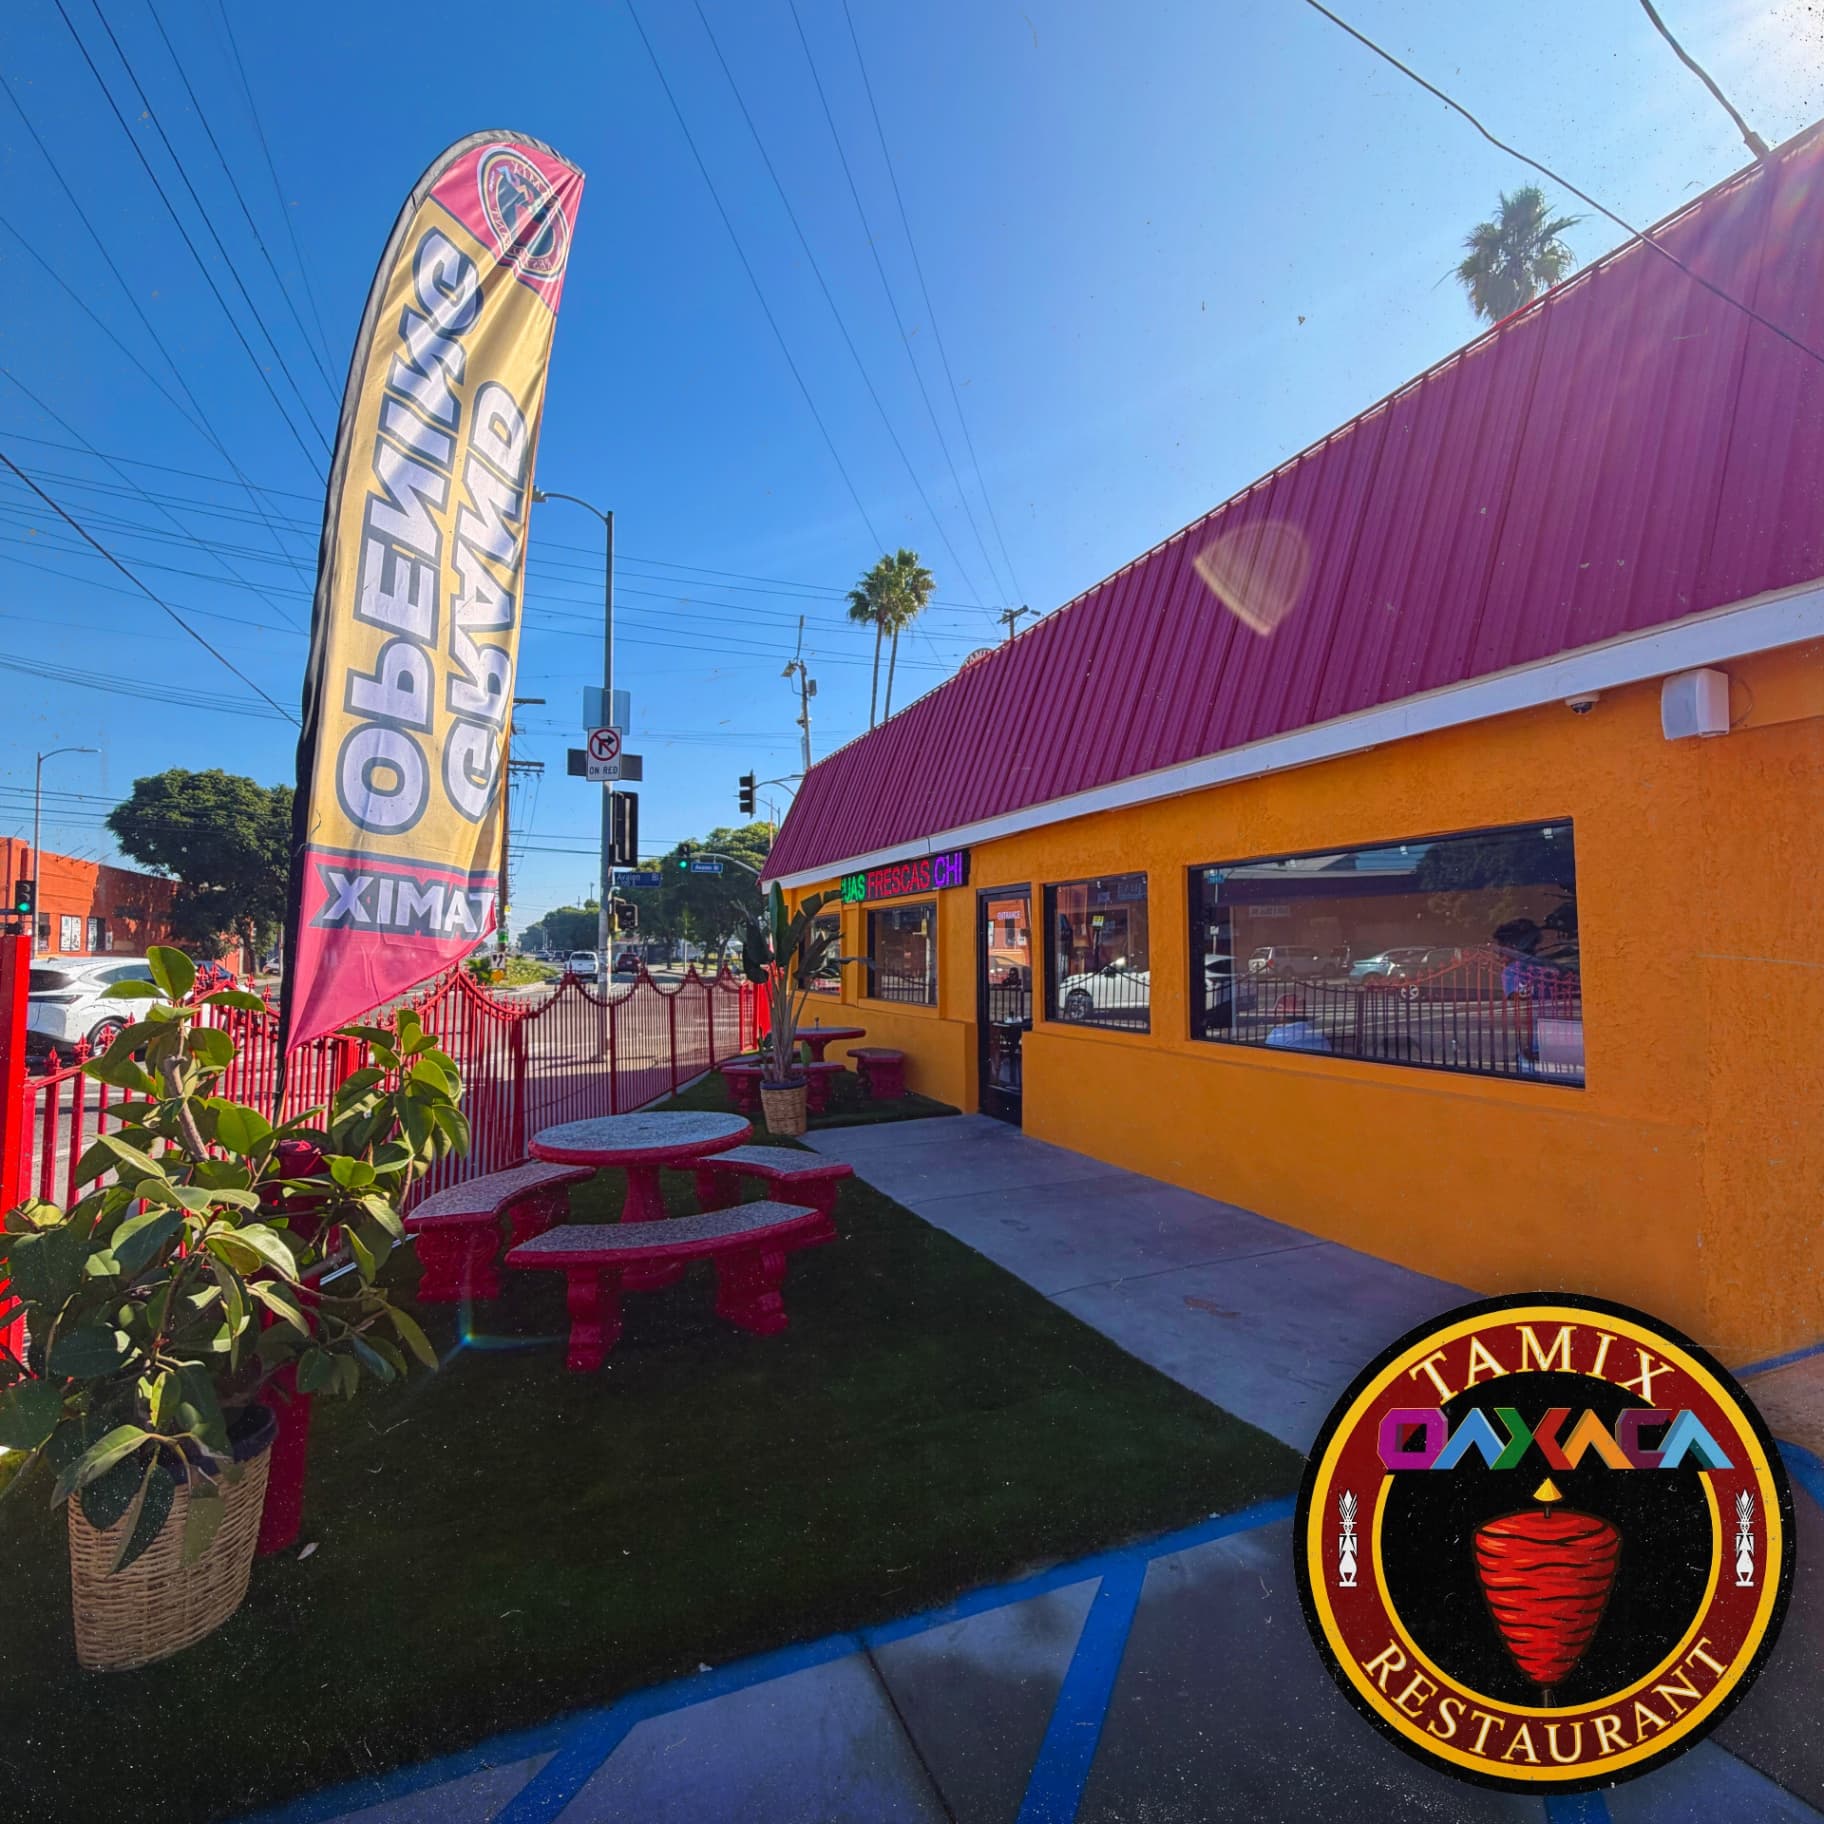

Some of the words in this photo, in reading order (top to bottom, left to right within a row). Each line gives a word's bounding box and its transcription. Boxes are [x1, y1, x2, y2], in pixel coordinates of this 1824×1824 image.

[589, 766, 600, 775] ON
[602, 766, 618, 775] RED
[867, 861, 931, 898] FRESCAS
[934, 851, 963, 888] CHI
